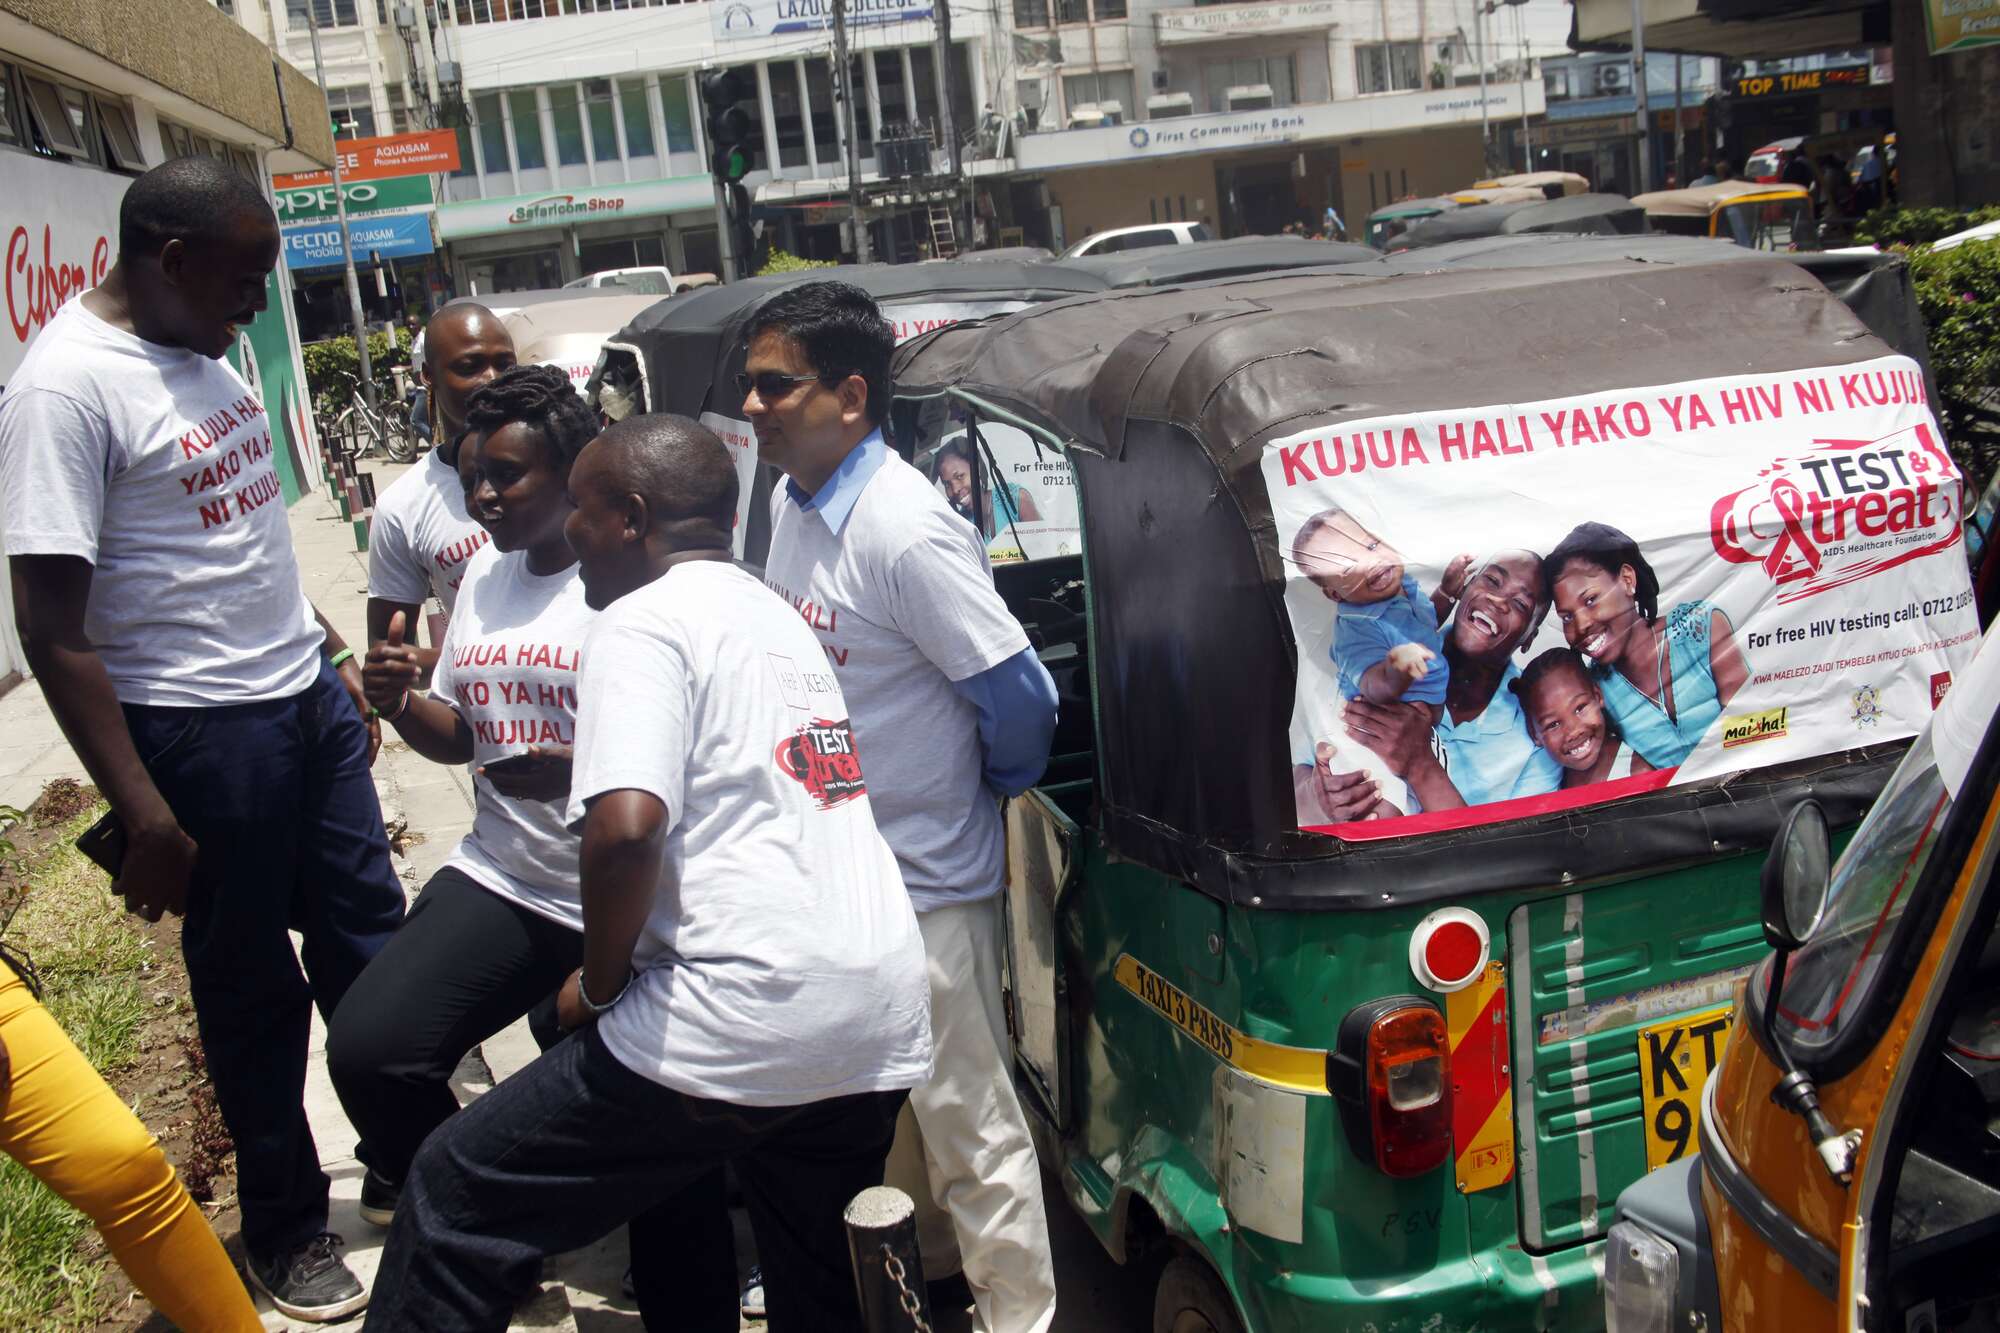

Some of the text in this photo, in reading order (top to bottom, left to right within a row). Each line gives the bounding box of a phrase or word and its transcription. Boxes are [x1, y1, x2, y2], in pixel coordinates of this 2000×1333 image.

[843, 0, 917, 13] COLL
[1738, 77, 1774, 96] TOP
[1780, 72, 1822, 92] TIME
[1155, 131, 1184, 143] First
[1190, 121, 1266, 140] Community
[1271, 114, 1304, 129] Bank
[375, 143, 430, 157] AQUASAM
[284, 231, 342, 250] TECNO
[351, 230, 394, 243] AQUASAM
[305, 246, 343, 259] mobile
[179, 409, 240, 461] KUJUA
[1279, 426, 1430, 487] KUJUA
[1438, 415, 1534, 464] HALI
[1540, 400, 1652, 448] YAKO
[1658, 393, 1716, 433] YA
[1720, 383, 1783, 425] HIV
[1793, 378, 1836, 415] NI
[179, 449, 240, 495] YAKO
[240, 436, 263, 465] YA
[1014, 461, 1072, 473] For free HIV
[1799, 449, 1931, 499] TEST &
[1042, 475, 1064, 486] 0712
[198, 498, 231, 530] NI
[1806, 475, 1939, 545] treat
[1822, 532, 1937, 558] AIDS Healthcare Foundation
[1748, 633, 1771, 649] For
[1775, 627, 1805, 644] free
[1809, 619, 1836, 638] HIV
[1840, 612, 1890, 636] testing
[1894, 603, 1920, 626] call:
[1922, 597, 1954, 617] 0712
[453, 644, 579, 671] UJUA HALI
[1753, 672, 1773, 686] KWA
[1774, 666, 1811, 682] MAELEZO
[1812, 661, 1835, 675] ZAIDI
[1836, 652, 1877, 670] TEMBELEA
[1877, 649, 1901, 662] KITUO
[498, 681, 533, 705] YA
[803, 673, 841, 694] KENY
[810, 728, 850, 755] TEST
[1136, 965, 1233, 1060] TAXI 3 PASS
[1649, 1016, 1735, 1098] KT
